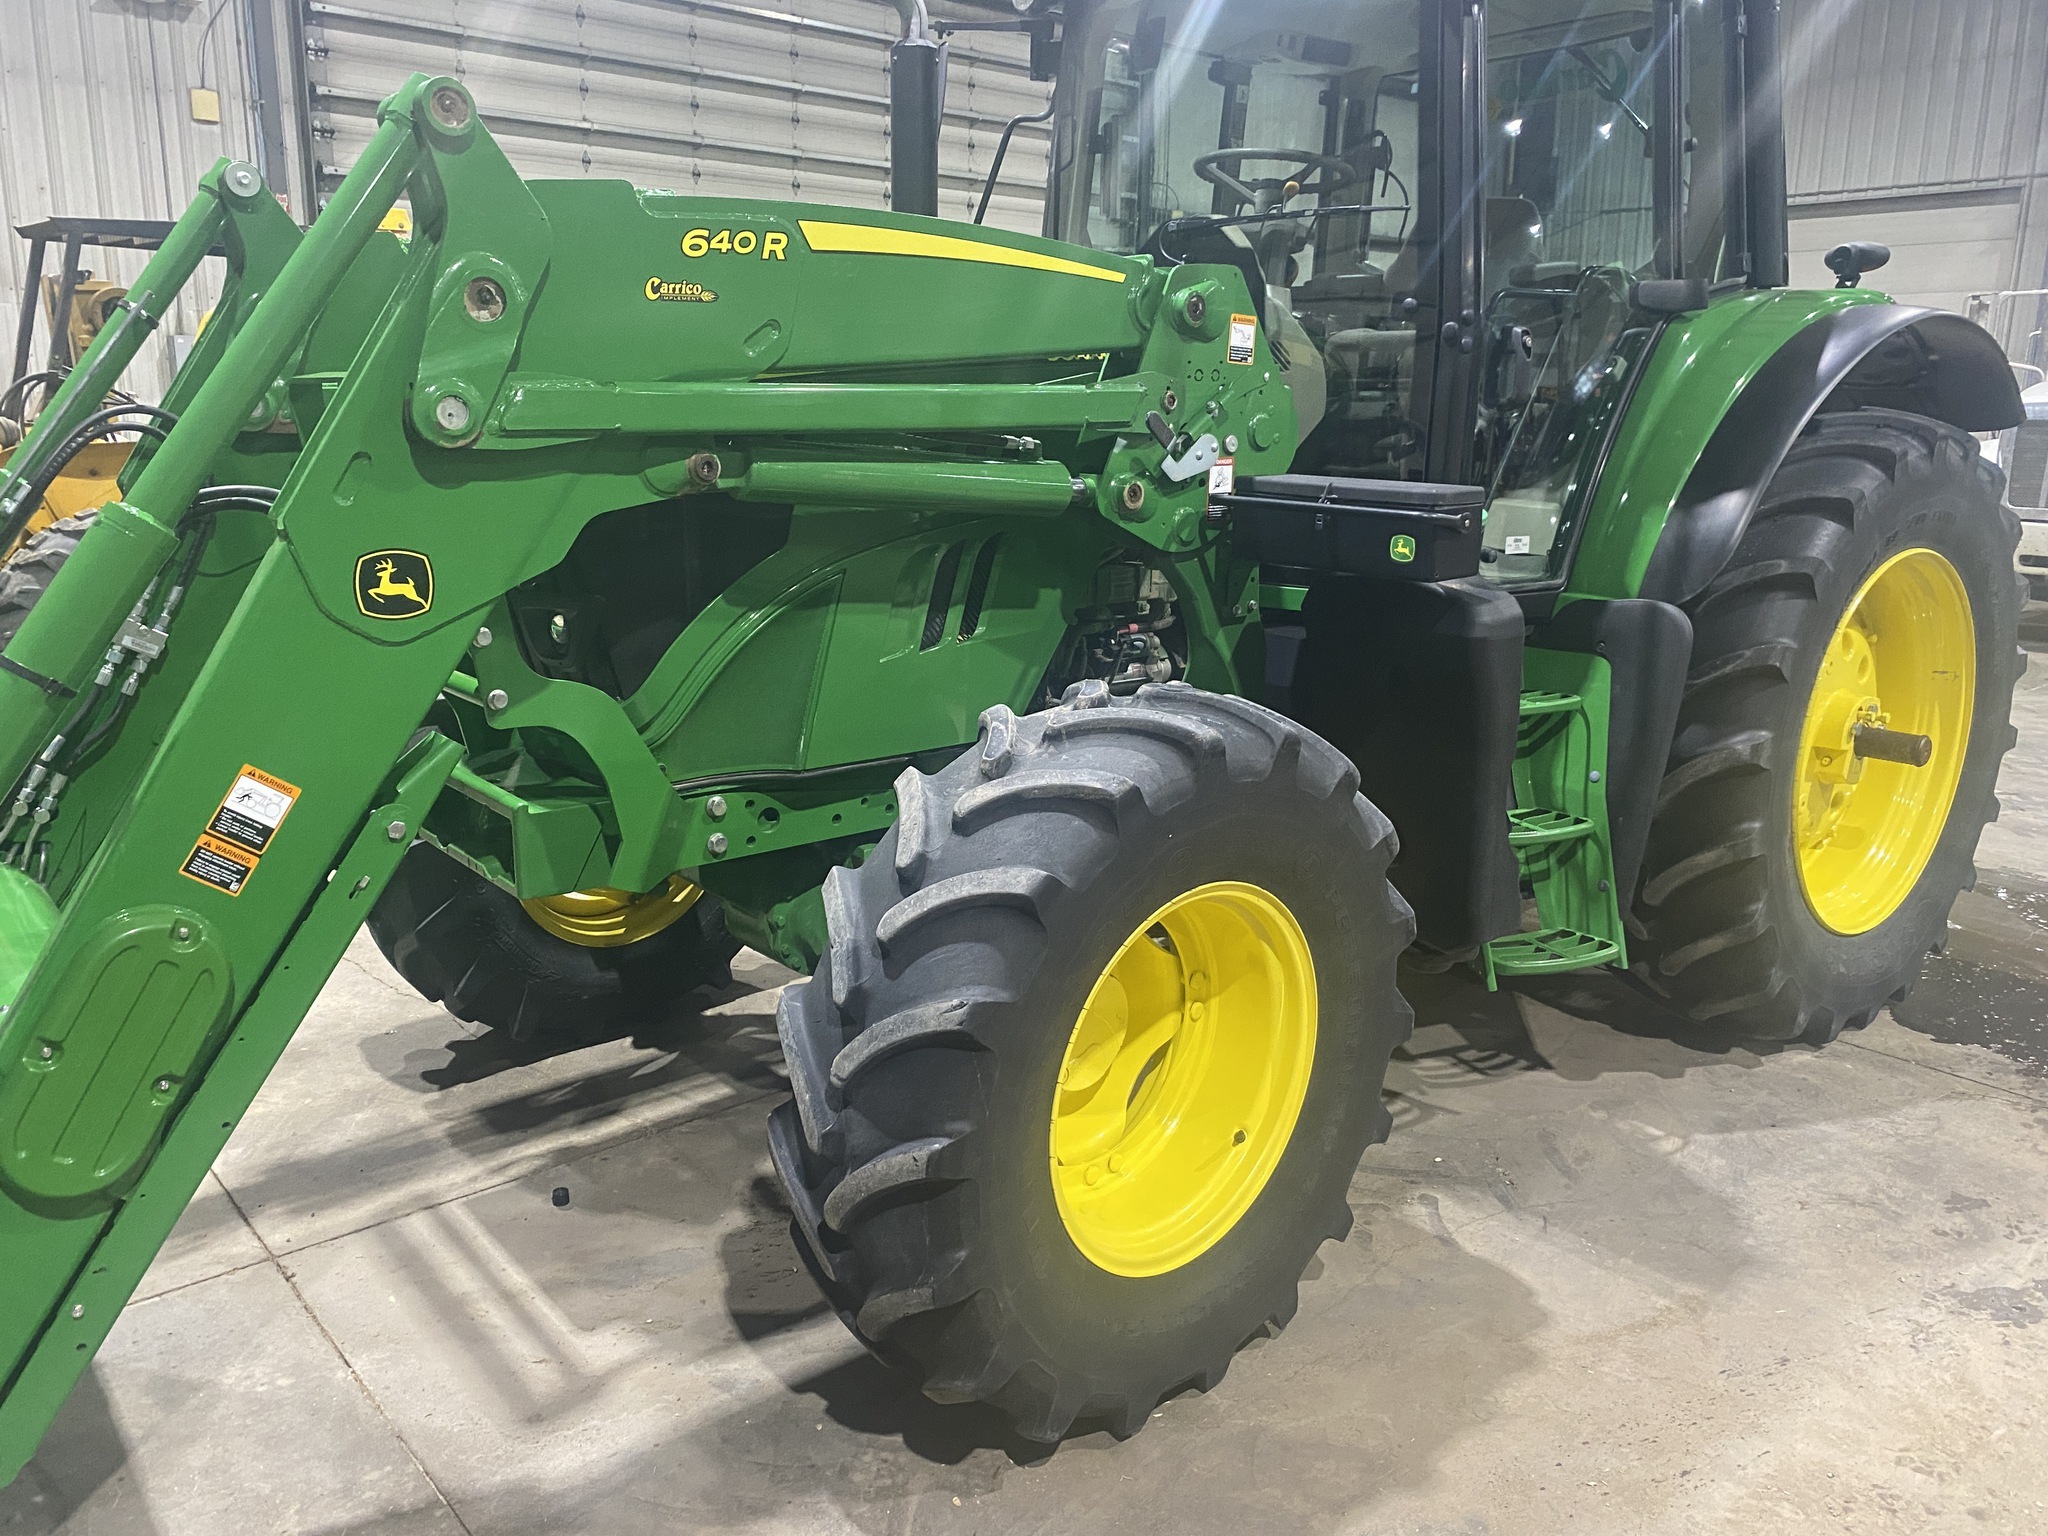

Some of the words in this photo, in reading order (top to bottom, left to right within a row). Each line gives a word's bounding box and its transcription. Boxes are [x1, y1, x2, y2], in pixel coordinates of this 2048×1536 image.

[645, 277, 702, 300] Carrico
[257, 773, 293, 795] WARNING
[215, 844, 251, 864] WARNING
